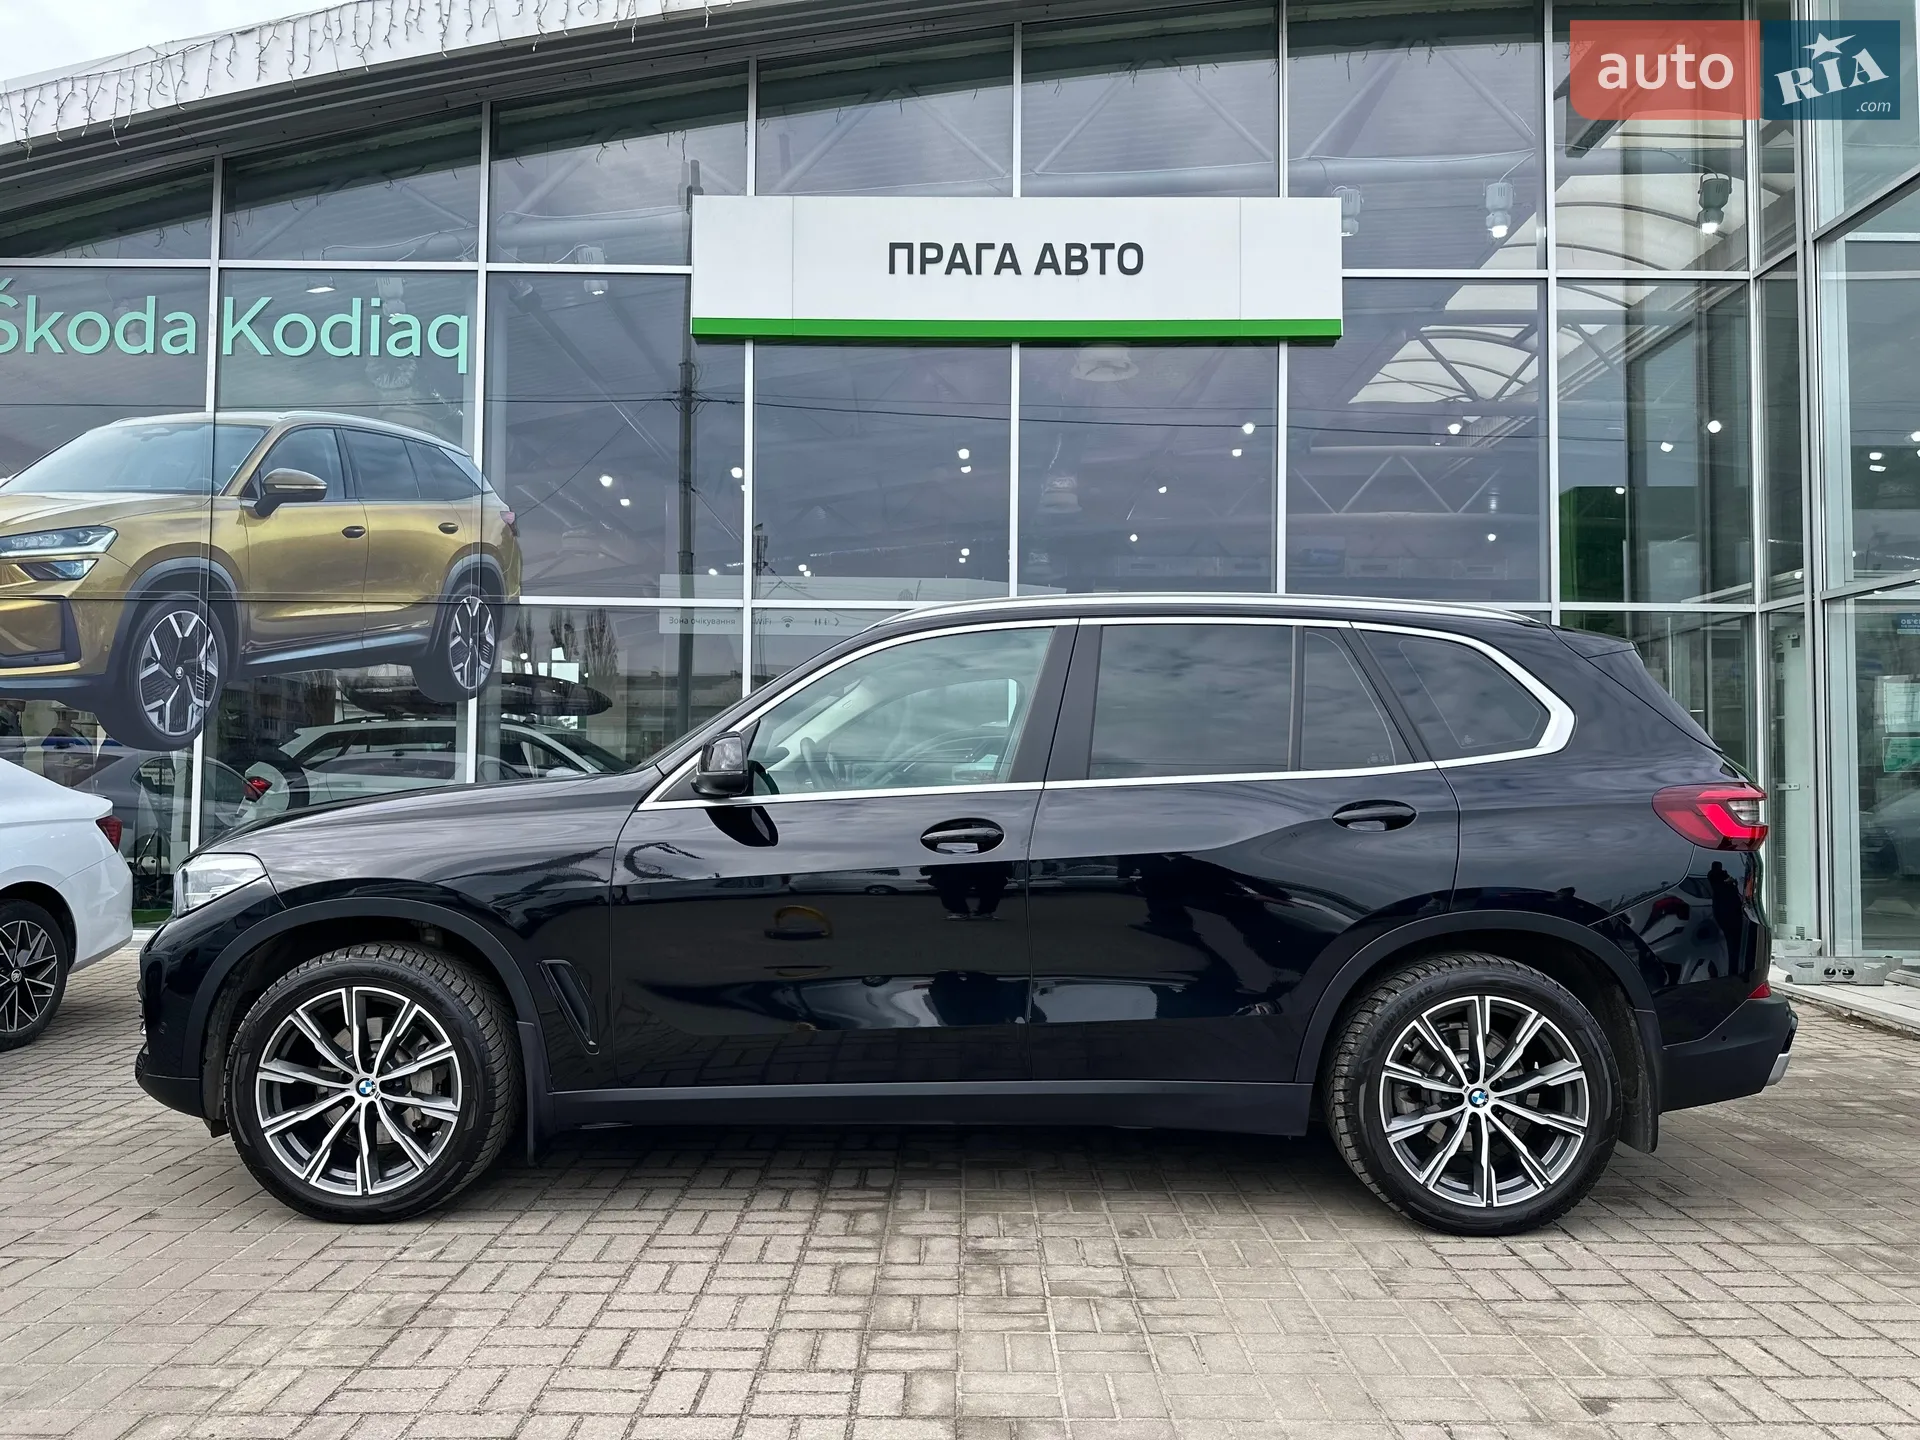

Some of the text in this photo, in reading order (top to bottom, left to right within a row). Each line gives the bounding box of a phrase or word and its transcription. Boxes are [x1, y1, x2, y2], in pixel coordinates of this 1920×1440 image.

[888, 242, 1144, 276] ПРАГА АВТО
[222, 296, 469, 374] Kodiaq
[669, 616, 689, 625] Зона
[690, 616, 736, 627] очікування
